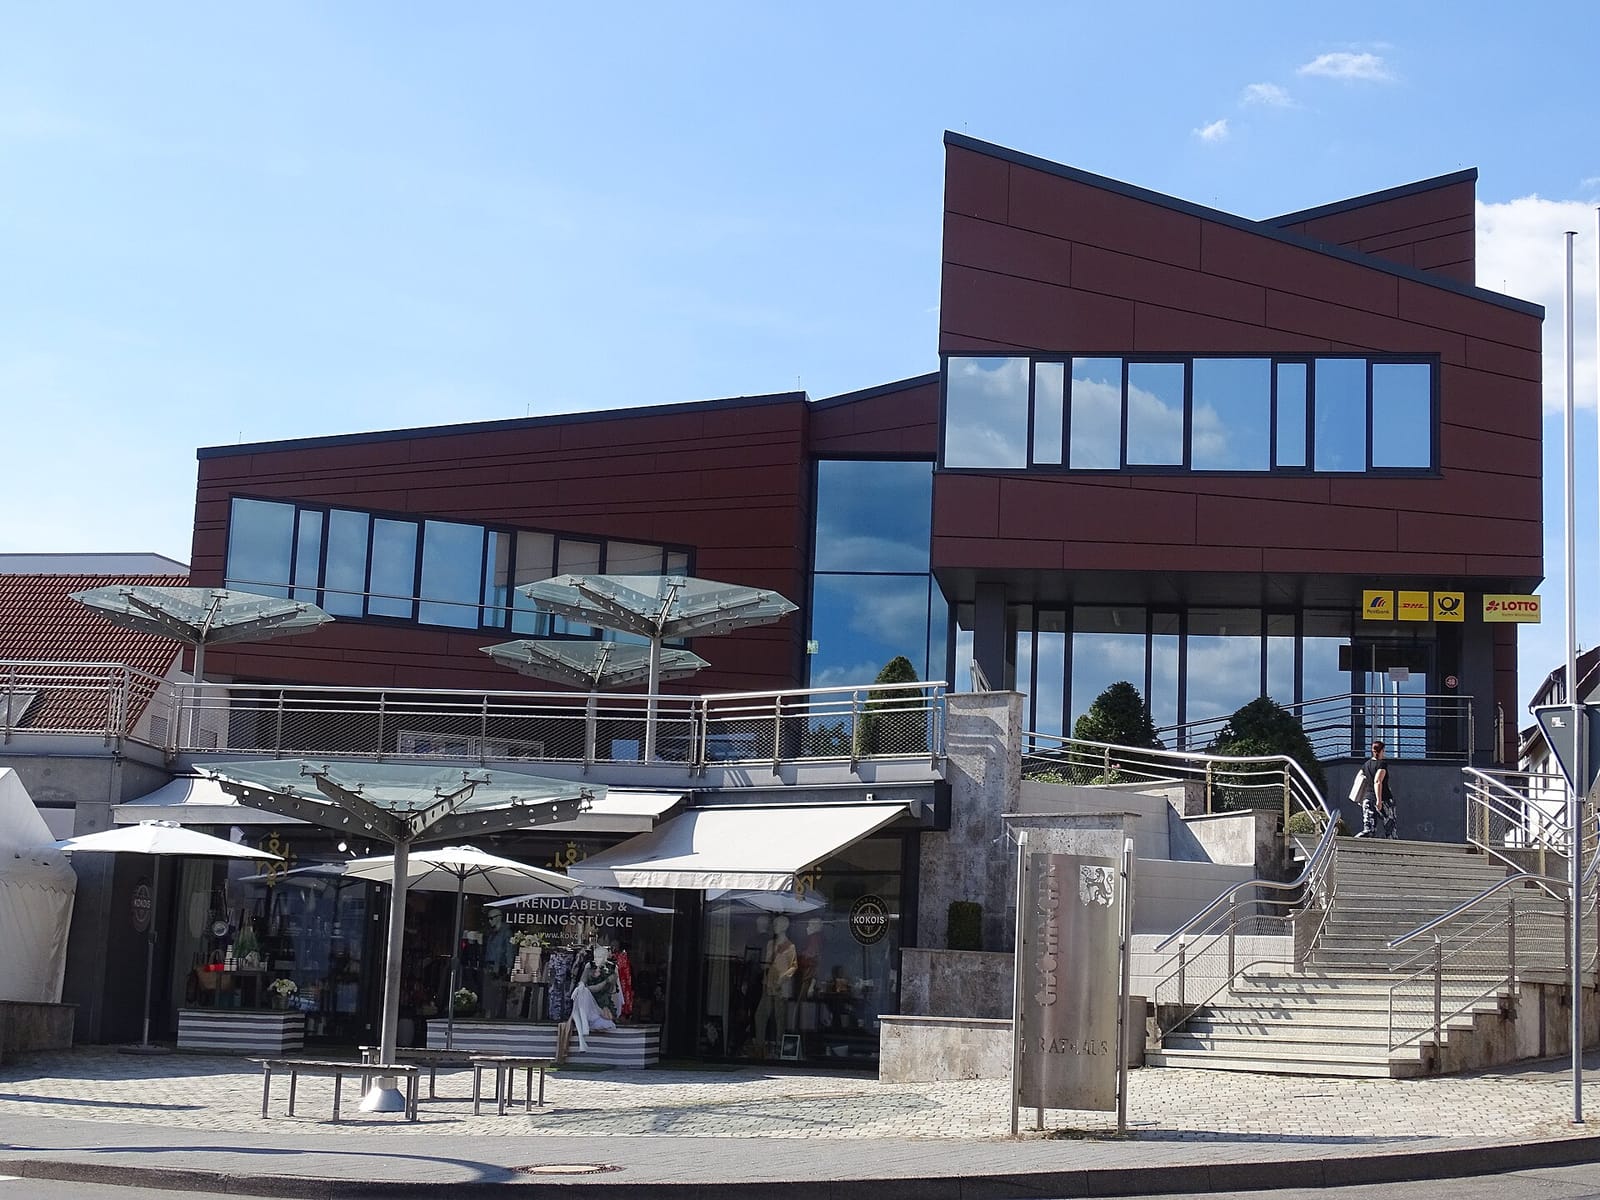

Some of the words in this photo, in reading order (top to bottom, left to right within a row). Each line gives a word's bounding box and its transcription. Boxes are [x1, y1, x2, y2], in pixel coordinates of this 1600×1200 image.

[1501, 601, 1538, 611] LOTTO
[514, 898, 613, 912] TRENDLABELS
[617, 901, 627, 912] &
[505, 912, 633, 928] LIEBLINGSSTÜCKE
[853, 916, 885, 925] KOKOIS
